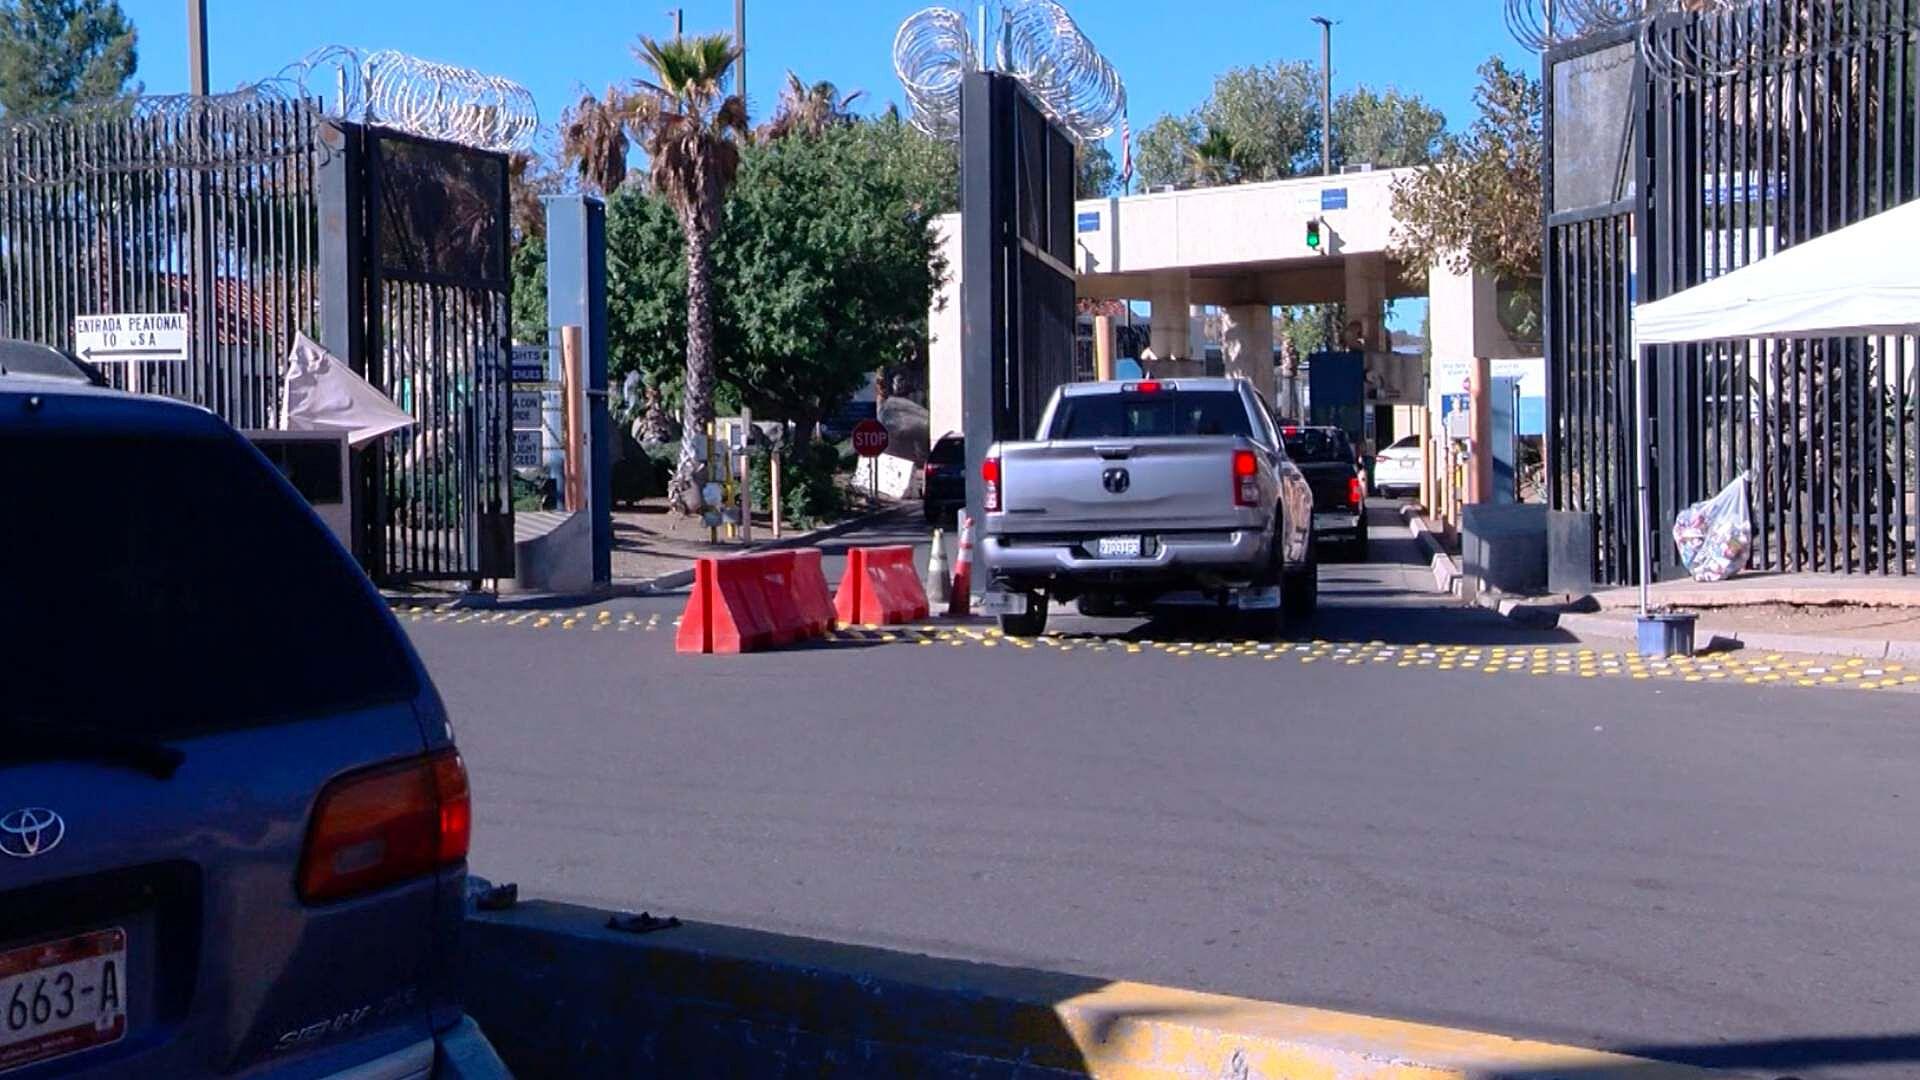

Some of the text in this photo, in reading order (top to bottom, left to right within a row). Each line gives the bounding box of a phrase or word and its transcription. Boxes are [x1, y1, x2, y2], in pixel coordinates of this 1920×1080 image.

[78, 316, 184, 333] ENTRADA PEATONAL
[103, 332, 116, 347] TO
[855, 432, 887, 446] STOP
